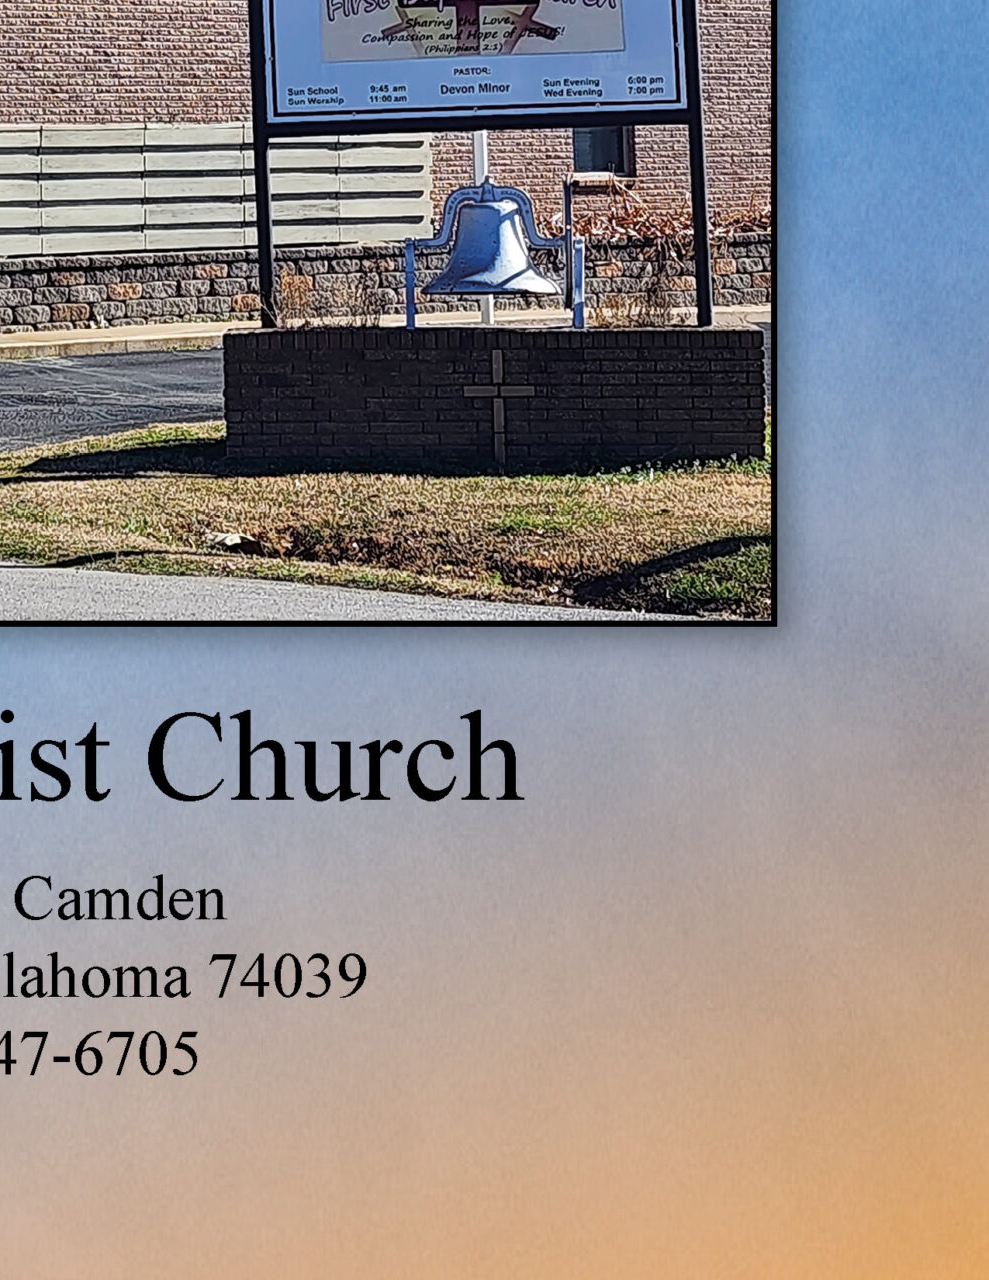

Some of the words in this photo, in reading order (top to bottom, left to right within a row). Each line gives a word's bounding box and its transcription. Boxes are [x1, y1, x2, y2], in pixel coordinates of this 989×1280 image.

[405, 16, 453, 30] Sharing
[457, 16, 478, 26] the
[361, 31, 433, 46] Compassion
[438, 29, 462, 41] and
[466, 29, 498, 42] Hope
[502, 26, 518, 39] of
[424, 43, 480, 56] (Philippians
[482, 42, 504, 54] 2:1)
[453, 67, 492, 76] PASTOR:
[542, 78, 562, 88] Sun
[563, 77, 601, 88] Evening
[627, 76, 647, 85] 6:00
[649, 76, 664, 86] pm
[287, 87, 305, 97] Sun
[307, 86, 339, 96] School
[369, 84, 389, 94] 9:45
[392, 85, 407, 93] am
[440, 84, 475, 95] Devon
[478, 82, 511, 94] Minor
[543, 88, 564, 98] Wed
[566, 87, 603, 98] Evening
[627, 86, 647, 95] 7:00
[649, 86, 664, 96] pm
[287, 98, 306, 106] Sun
[307, 96, 345, 106] Worship
[369, 95, 392, 104] 11:00
[393, 95, 408, 103] am
